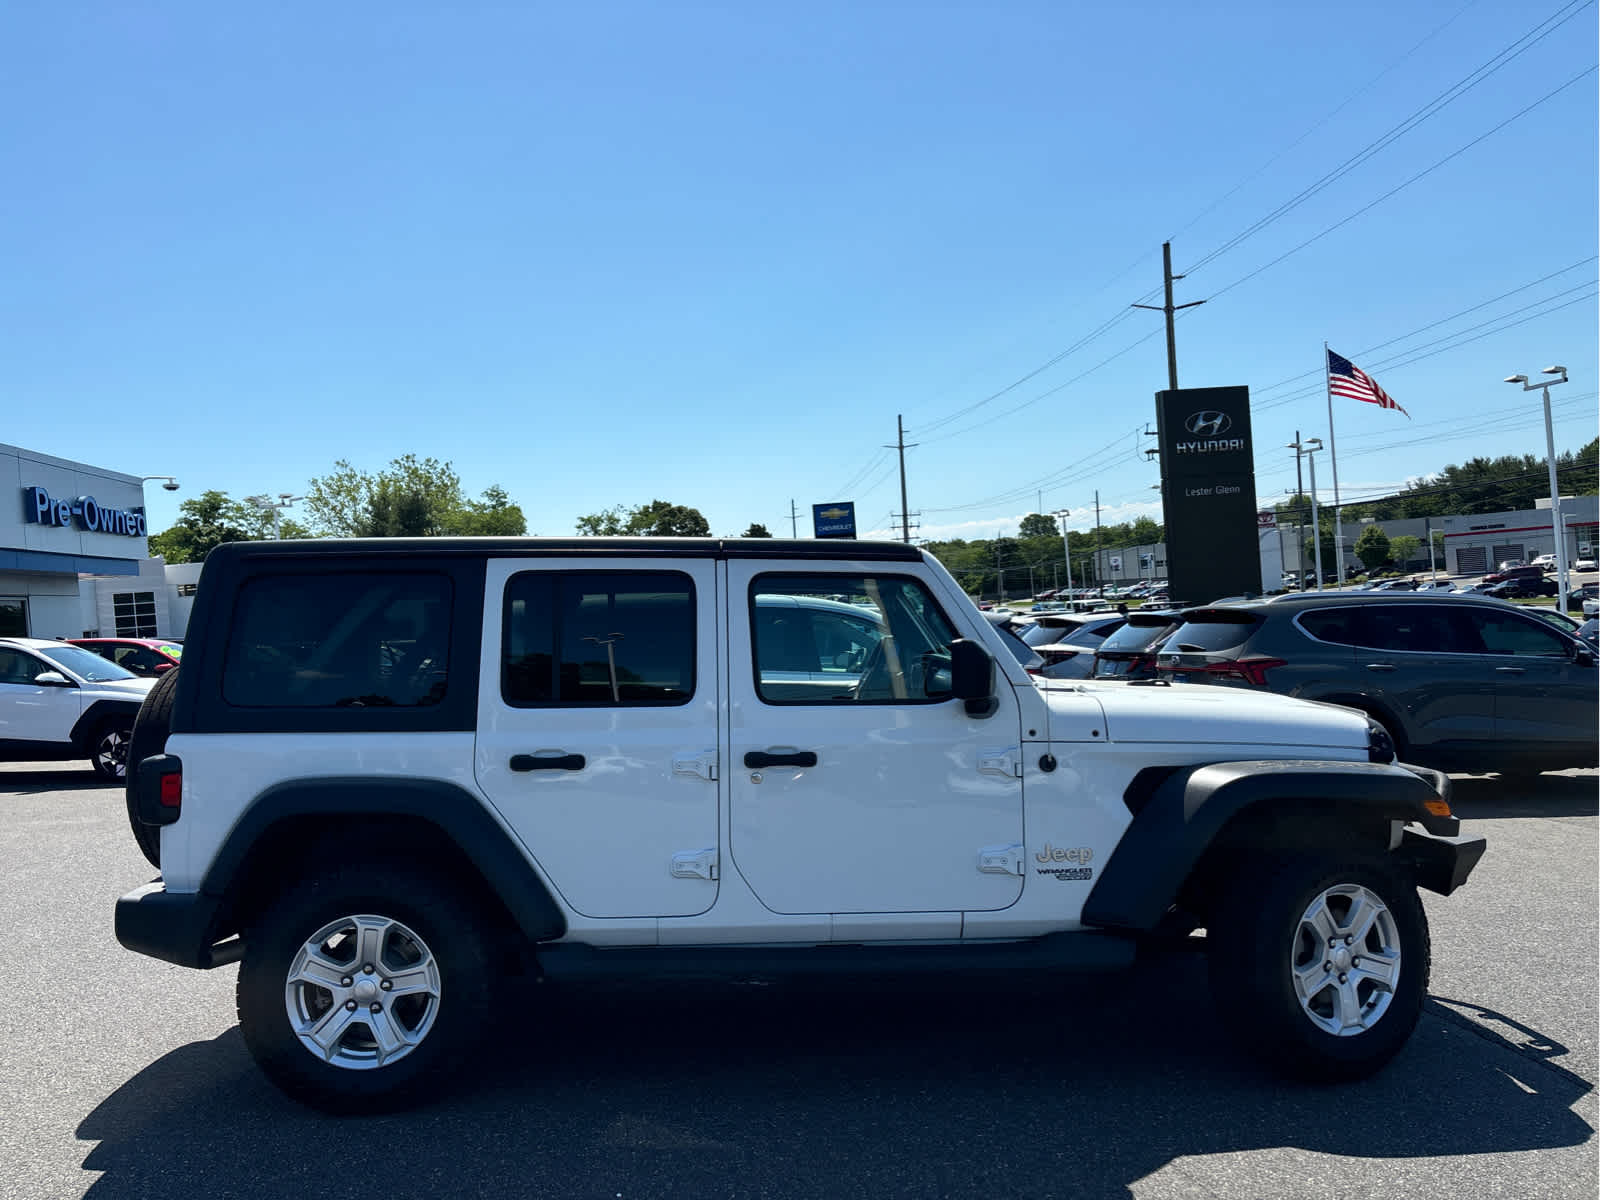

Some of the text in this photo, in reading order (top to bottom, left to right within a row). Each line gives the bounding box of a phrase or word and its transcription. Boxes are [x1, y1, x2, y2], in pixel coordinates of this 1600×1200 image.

[1176, 439, 1243, 454] HYUNDAI
[1185, 485, 1240, 496] Lester Glenn
[28, 486, 147, 537] Pre-Owned
[1036, 843, 1093, 865] Jeep
